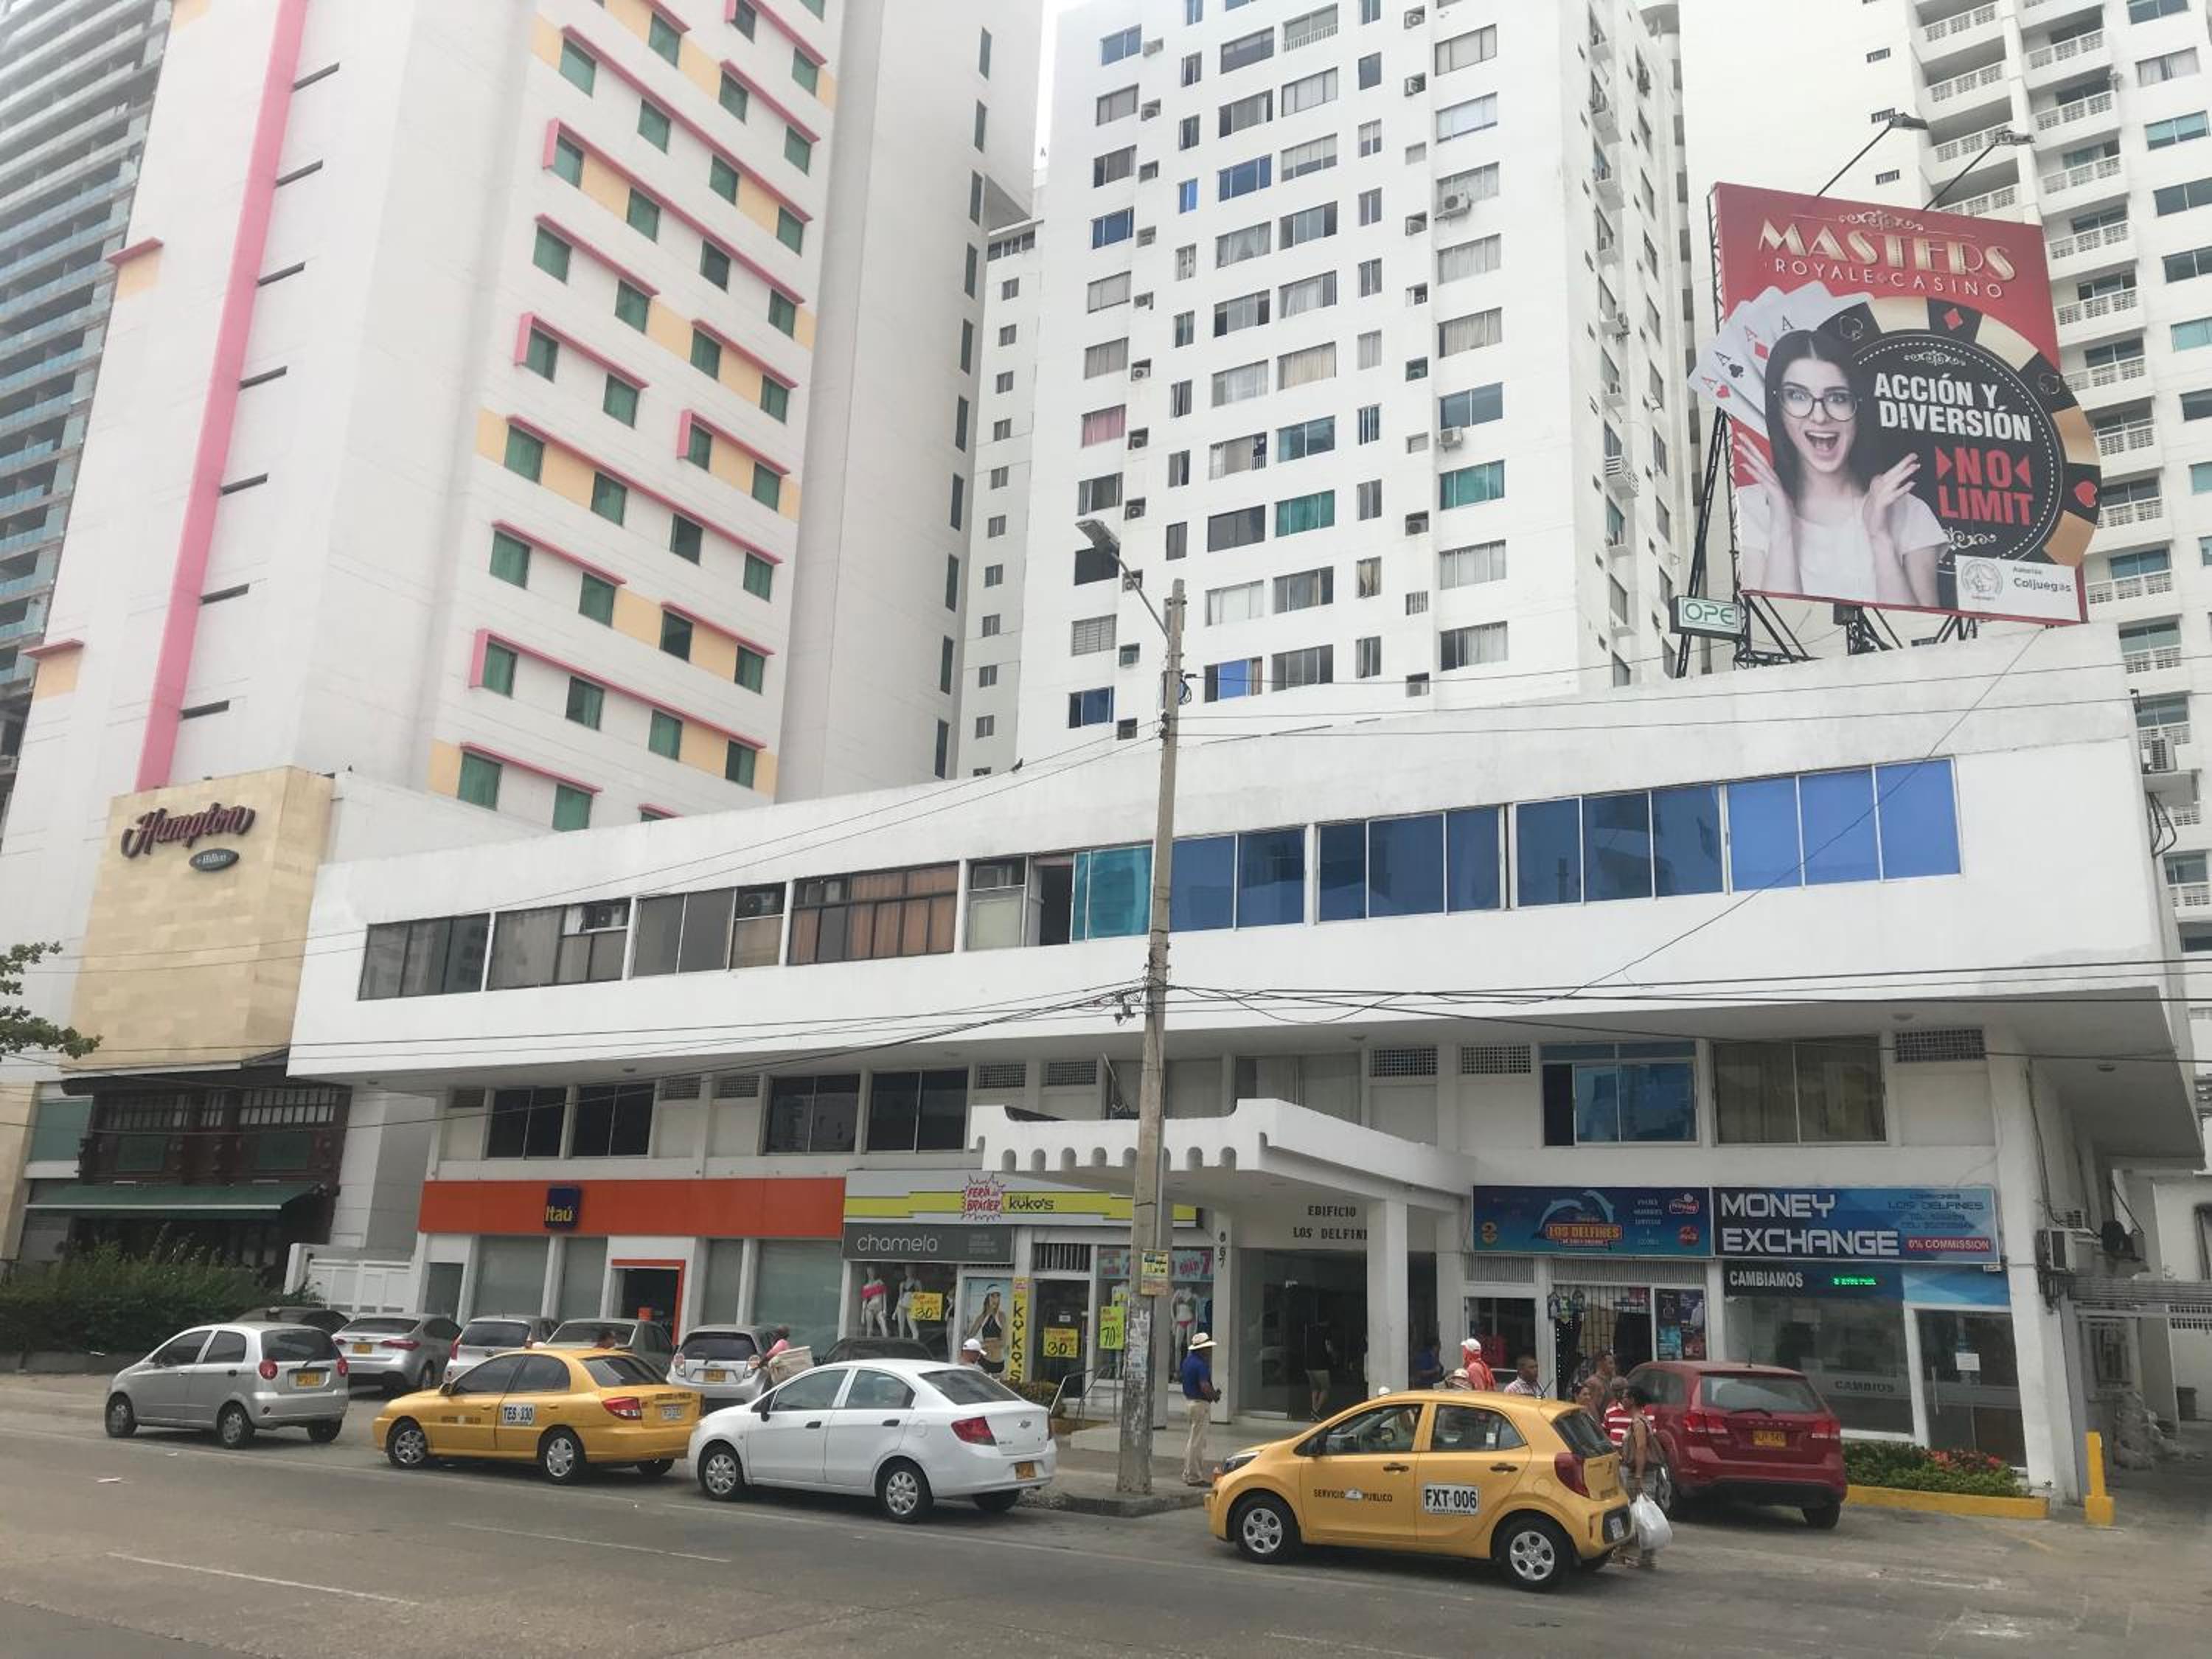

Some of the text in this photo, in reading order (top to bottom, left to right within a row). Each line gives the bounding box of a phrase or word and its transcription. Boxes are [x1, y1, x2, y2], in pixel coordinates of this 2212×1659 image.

[1759, 220, 2015, 282] MASTERS
[1775, 258, 2003, 298] ROYALE CASINO
[1874, 372, 1997, 409] ACCIÓN Y
[1879, 400, 2032, 442] DIVERSIÓN
[1955, 448, 2012, 488] NO
[1938, 485, 2034, 526] LIMIT
[121, 801, 256, 858] Hampton
[545, 1205, 573, 1222] Itaú
[1009, 1195, 1054, 1210] kuko's
[1308, 1206, 1356, 1217] EDIFICIO
[1721, 1192, 1835, 1218] MONEY
[856, 1234, 938, 1252] chamela
[1293, 1226, 1312, 1238] LOS
[1722, 1228, 1899, 1256] EXCHANGE
[1925, 1239, 1989, 1251] COMMISSION
[1729, 1270, 1804, 1287] CAMBIAMOS
[1834, 1380, 1895, 1394] CAMBIOS
